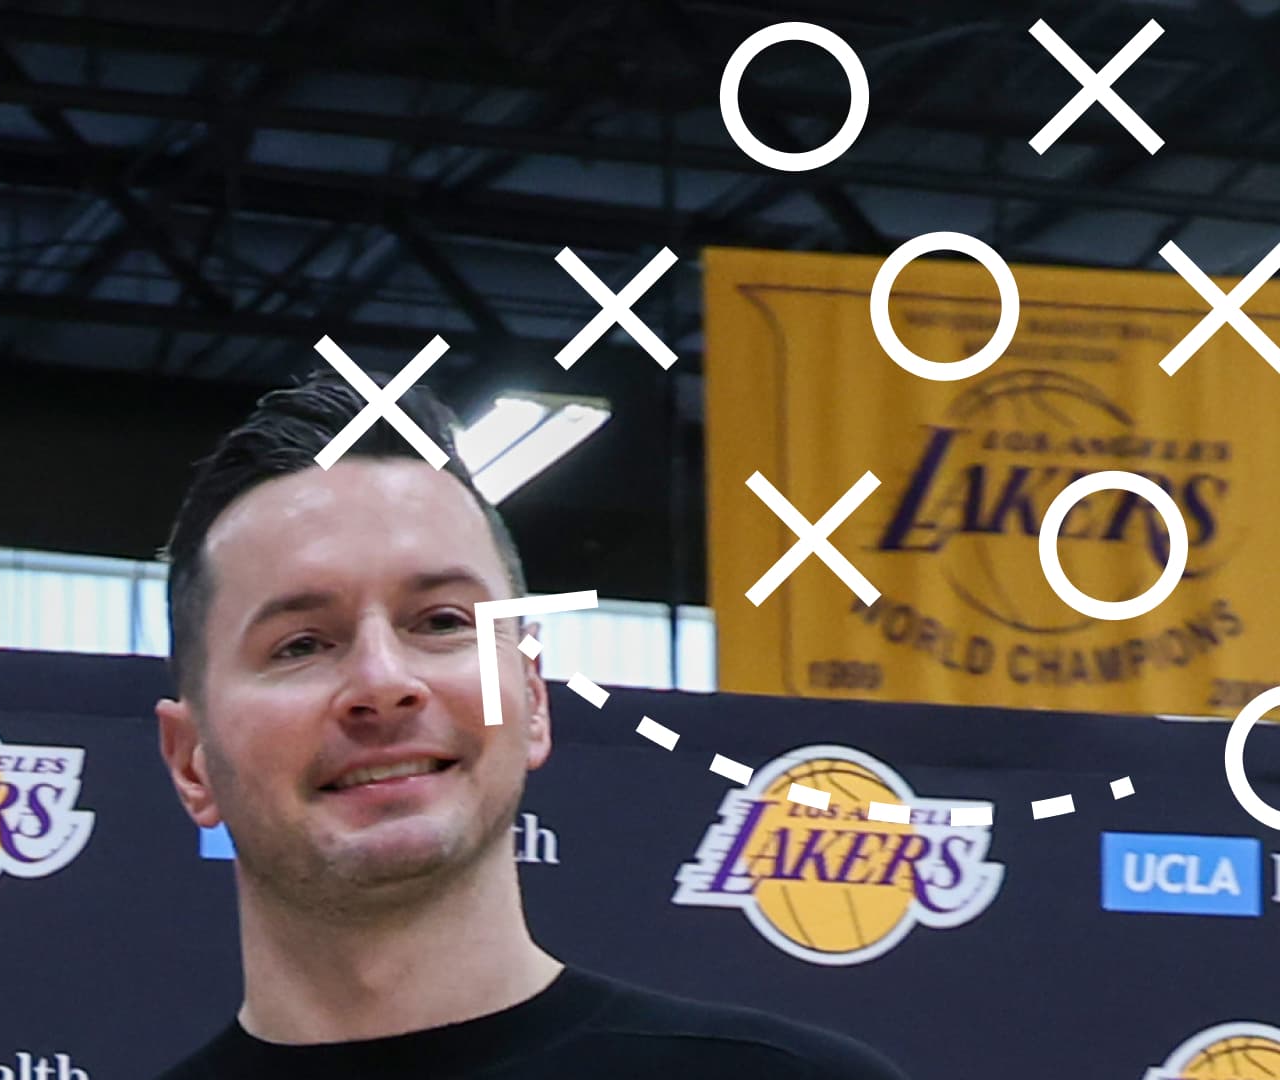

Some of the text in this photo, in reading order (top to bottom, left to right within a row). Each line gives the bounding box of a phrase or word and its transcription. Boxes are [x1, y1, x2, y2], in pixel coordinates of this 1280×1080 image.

[1007, 597, 1244, 684] CHAMPIONS
[692, 799, 988, 913] LAKERS
[1123, 852, 1241, 897] UCLA
